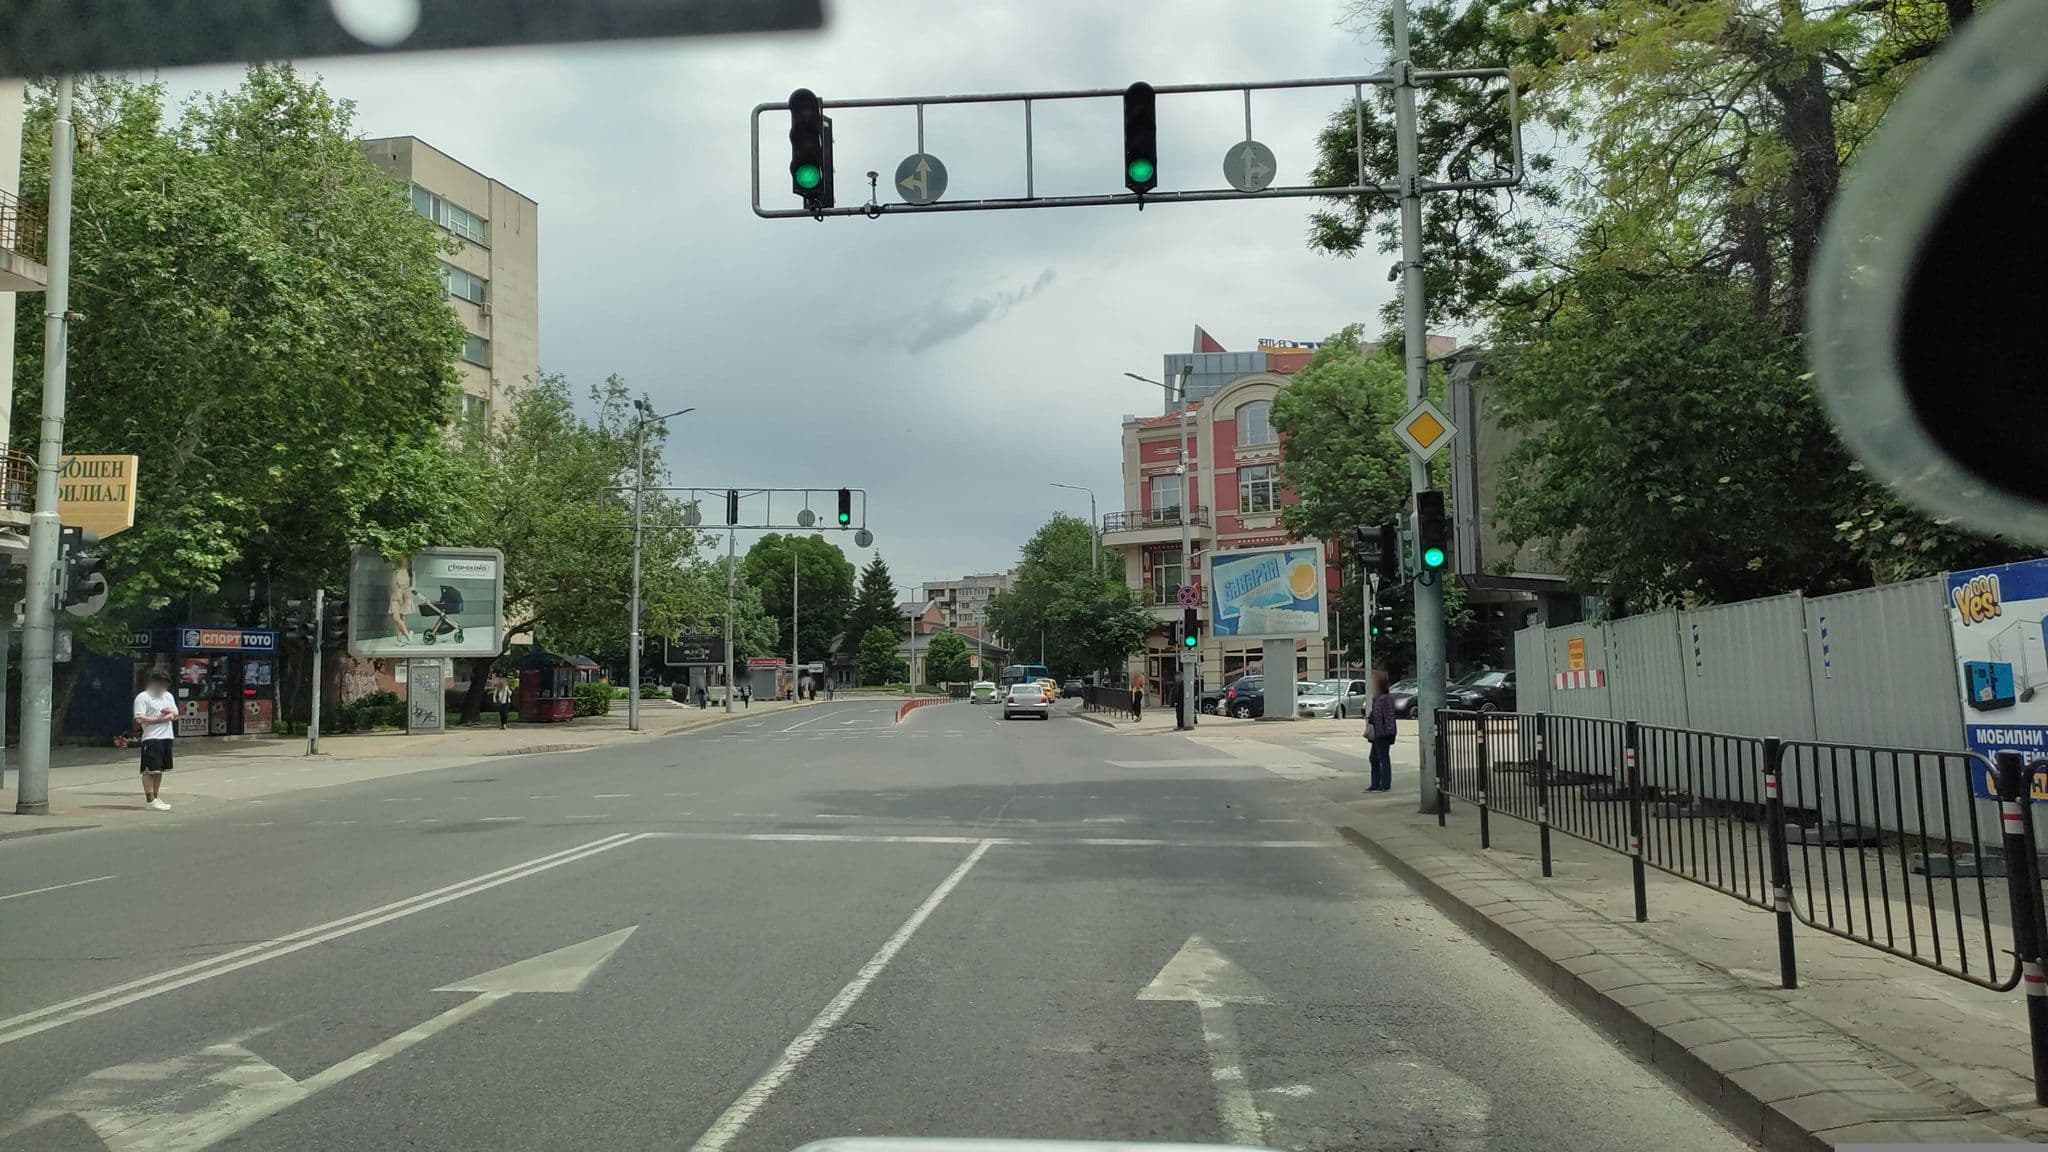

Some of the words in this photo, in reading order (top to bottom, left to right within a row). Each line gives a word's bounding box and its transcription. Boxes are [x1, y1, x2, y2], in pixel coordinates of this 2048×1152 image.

[202, 630, 241, 644] СПОРТ
[243, 635, 272, 646] ТОТО
[1976, 729, 2043, 745] МОБИЛНИ
